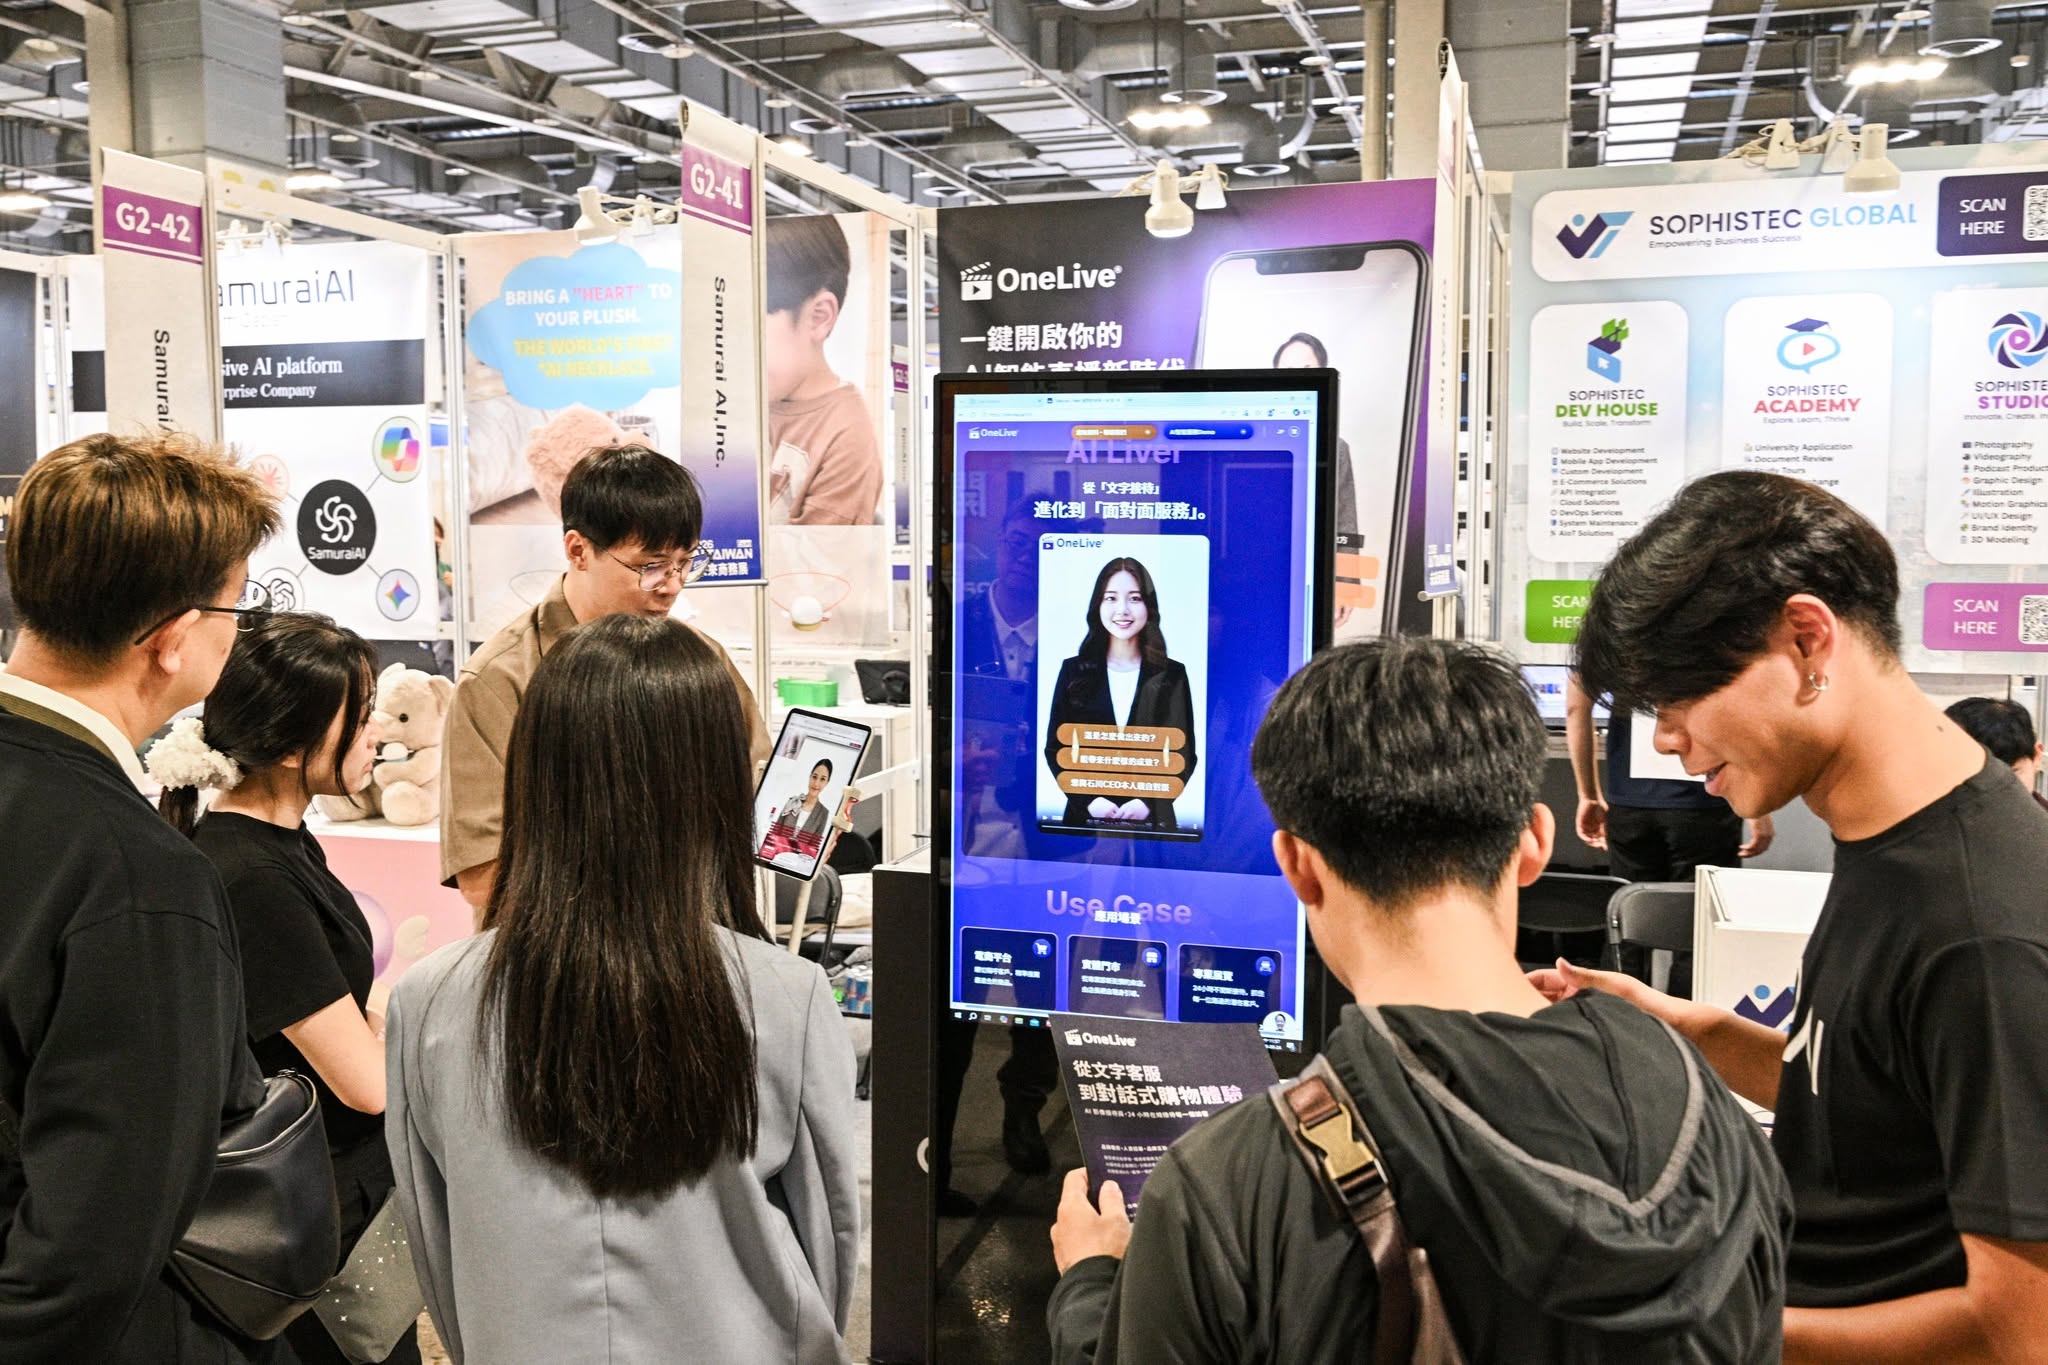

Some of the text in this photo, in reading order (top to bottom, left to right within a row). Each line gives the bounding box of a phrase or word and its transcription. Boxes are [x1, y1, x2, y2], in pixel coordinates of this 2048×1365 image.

[690, 163, 744, 210] G2-41
[1959, 197, 2007, 214] SCAN
[115, 202, 192, 243] G2-42
[1649, 203, 1918, 236] SOPHISTEC GLOBAL
[1960, 220, 2006, 237] HERE
[1649, 232, 1802, 249] Empowering Business Success
[505, 283, 673, 306] BRING A "HEART" TO
[535, 307, 641, 327] YOUR PLUSH.
[714, 276, 728, 383] Samurai
[513, 338, 546, 357] THE
[252, 357, 272, 376] AI
[276, 356, 343, 379] platform
[260, 383, 317, 399] Company
[1569, 389, 1645, 401] SOPHISTEC
[1767, 384, 1849, 397] SOPHISTEC
[1555, 402, 1658, 418] DEV HOUSE
[1753, 398, 1861, 413] ACADEMY
[1065, 437, 1183, 465] AI Liver
[1754, 443, 1854, 452] University Application
[307, 546, 367, 561] SamuraiAI
[1952, 599, 1999, 613] SCAN
[1552, 616, 1583, 629] HER
[1953, 621, 1999, 634] HERE
[1046, 889, 1193, 925] Use Case
[1072, 1060, 1163, 1083] 從文字客服
[1078, 1082, 1243, 1107] 到對話式購物體驗
